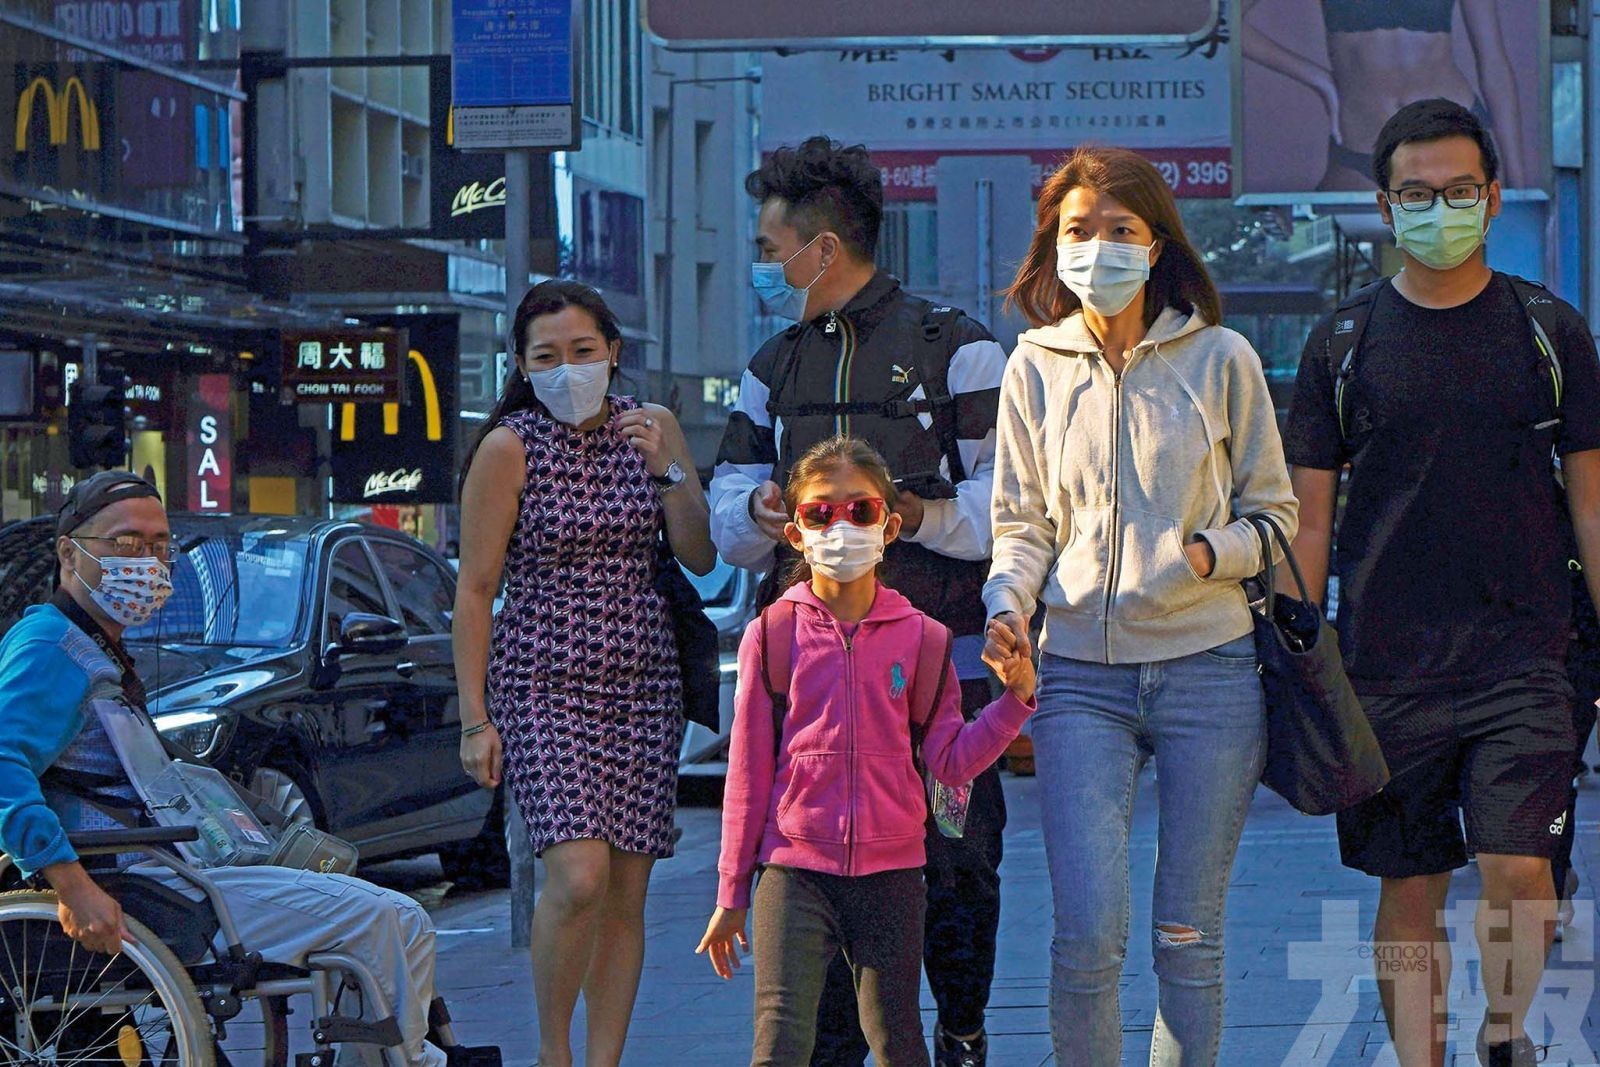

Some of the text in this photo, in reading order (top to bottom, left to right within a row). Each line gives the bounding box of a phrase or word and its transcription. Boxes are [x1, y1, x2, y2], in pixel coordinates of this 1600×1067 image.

[868, 79, 1206, 102] BRIGHT SMART SECURITIES
[1187, 161, 1234, 185] 396
[298, 341, 386, 370] 周大福
[297, 383, 385, 395] CHOW TAI FOOK
[198, 416, 221, 508] SAL
